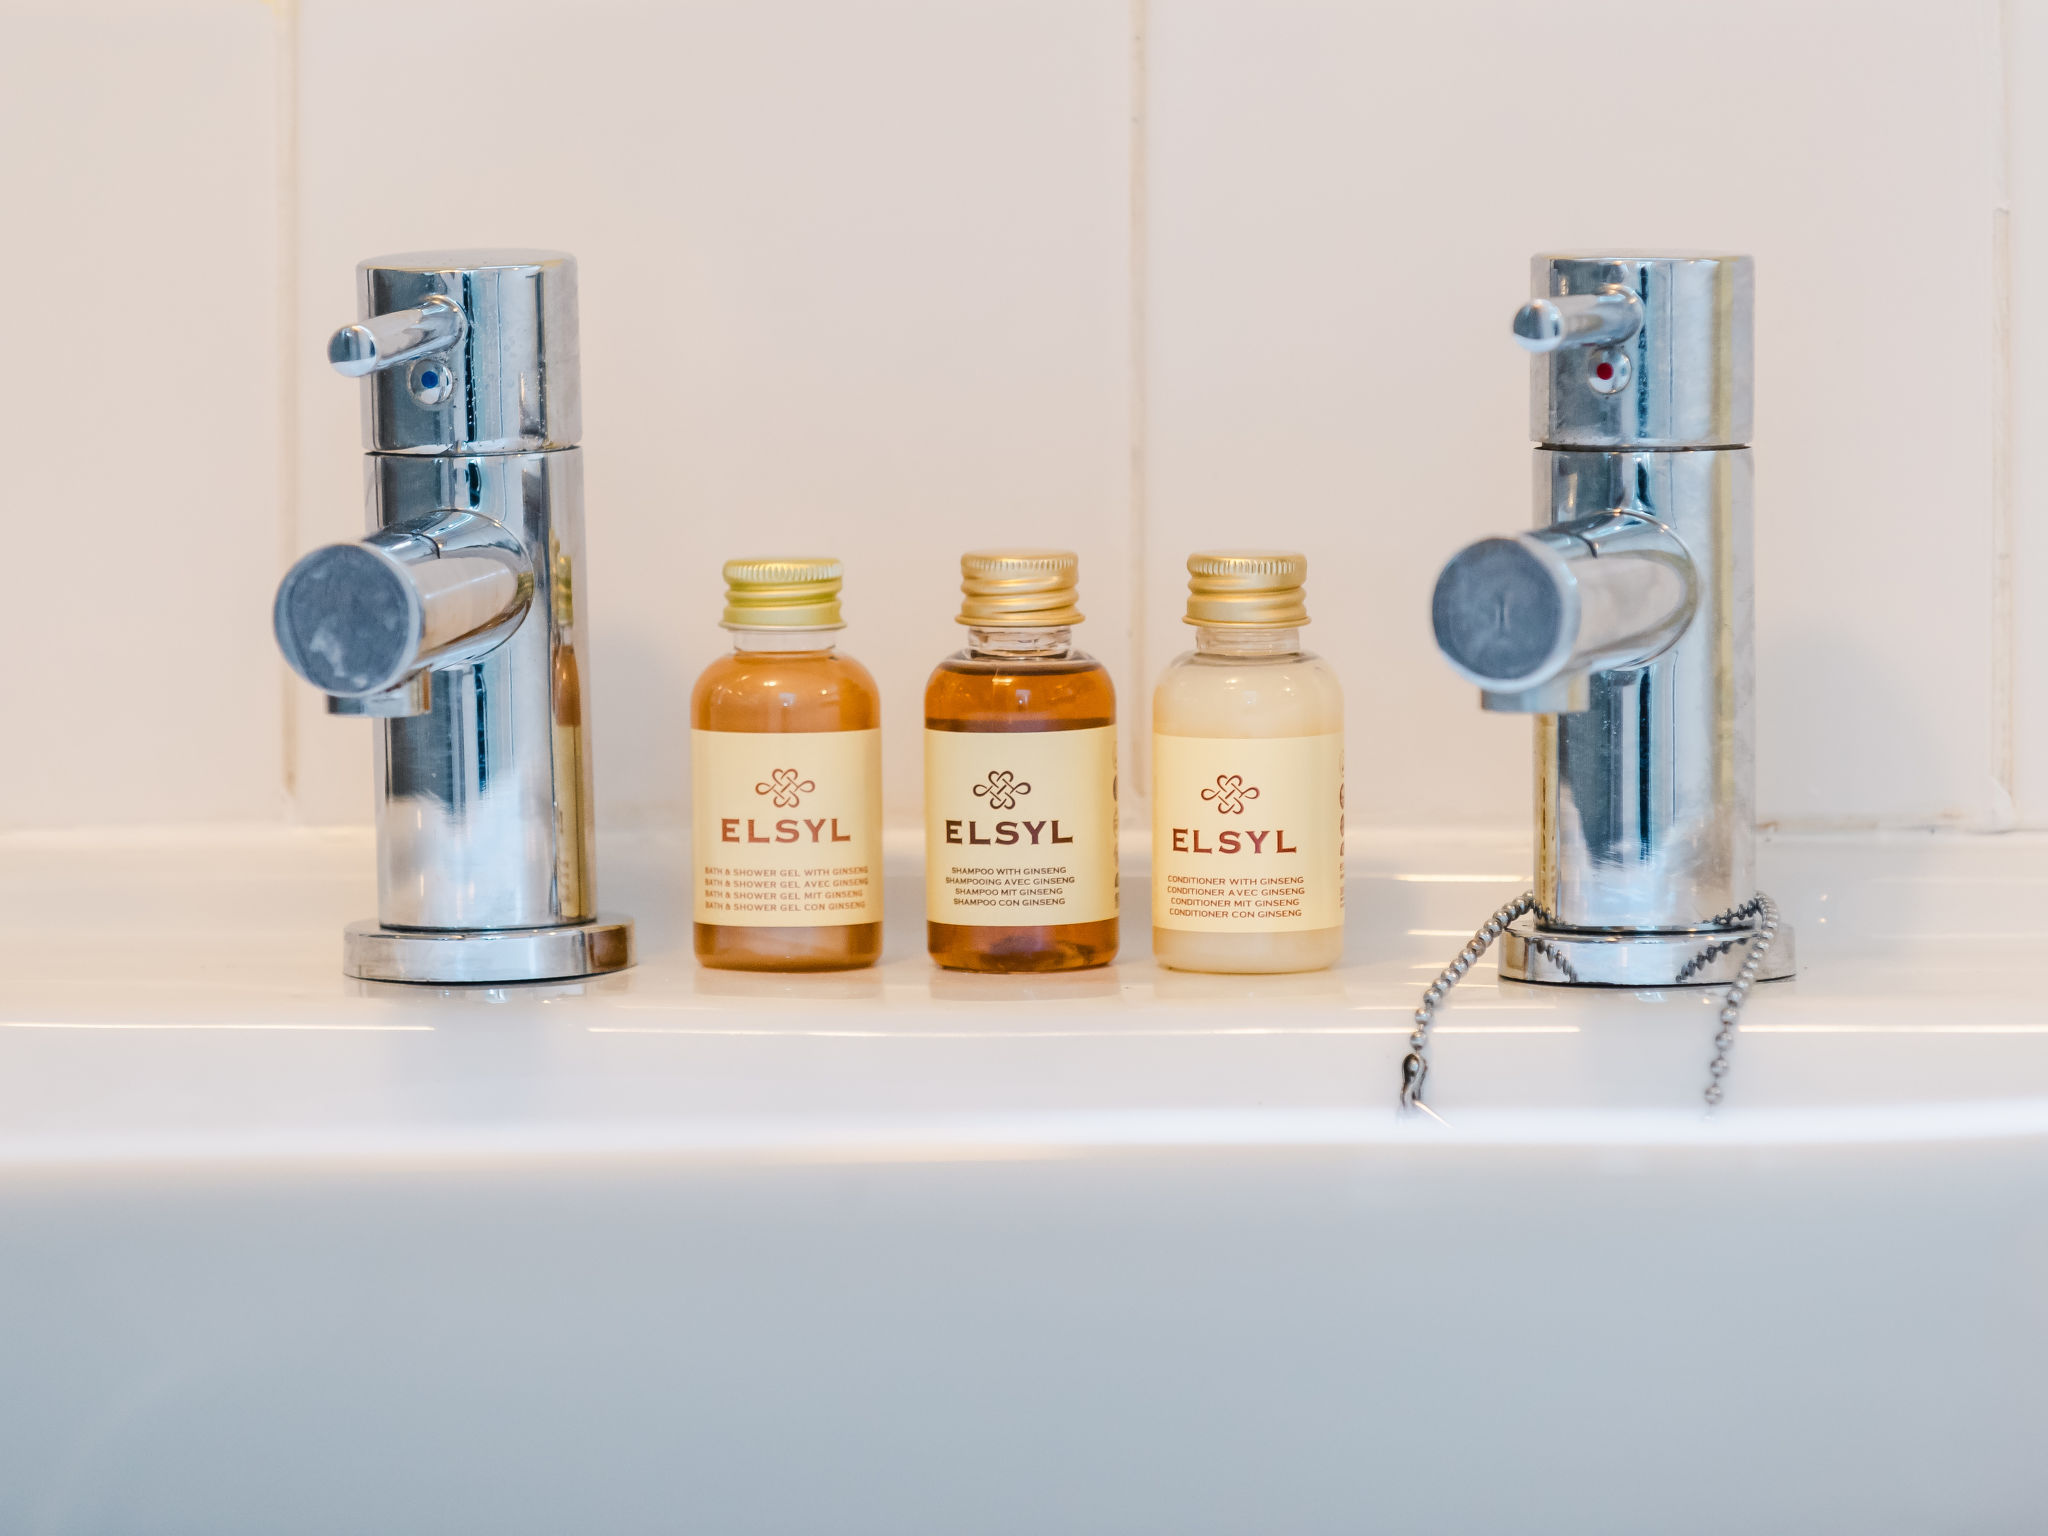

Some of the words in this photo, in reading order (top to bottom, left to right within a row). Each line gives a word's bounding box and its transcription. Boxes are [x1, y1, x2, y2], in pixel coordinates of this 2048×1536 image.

[722, 819, 851, 843] ELSYL
[946, 820, 1073, 845] ELSYL
[1173, 828, 1297, 854] ELSYL
[705, 867, 722, 875] BATH
[733, 869, 776, 877] SHOWER
[832, 866, 868, 875] GINSENG
[952, 867, 994, 875] SHAMPOO
[1023, 867, 1066, 875] GINSENG
[705, 879, 722, 887] BATH
[780, 881, 800, 889] GEL
[833, 878, 869, 886] GINSENG
[946, 877, 1001, 886] SHAMPOOING
[1033, 877, 1075, 885] GINSENG
[1168, 875, 1225, 885] CONDITIONER
[1260, 877, 1304, 885] GINSENG
[705, 890, 722, 898] BATH
[733, 892, 776, 900] SHOWER
[825, 890, 863, 899] GINSENG
[955, 888, 999, 896] SHAMPOO
[1019, 888, 1063, 896] GINSENG
[1168, 886, 1224, 896] CONDITIONER
[1261, 888, 1305, 896] GINSENG
[705, 902, 723, 910] BATH
[780, 904, 800, 912] GEL
[828, 901, 865, 910] GINSENG
[954, 898, 996, 906] SHAMPOO
[1022, 898, 1065, 906] GINSENG
[1171, 897, 1231, 907] CONDITIONER
[1255, 898, 1300, 907] GINSENG
[1170, 908, 1228, 918] CONDITIONER
[1257, 909, 1302, 918] GINSENG
